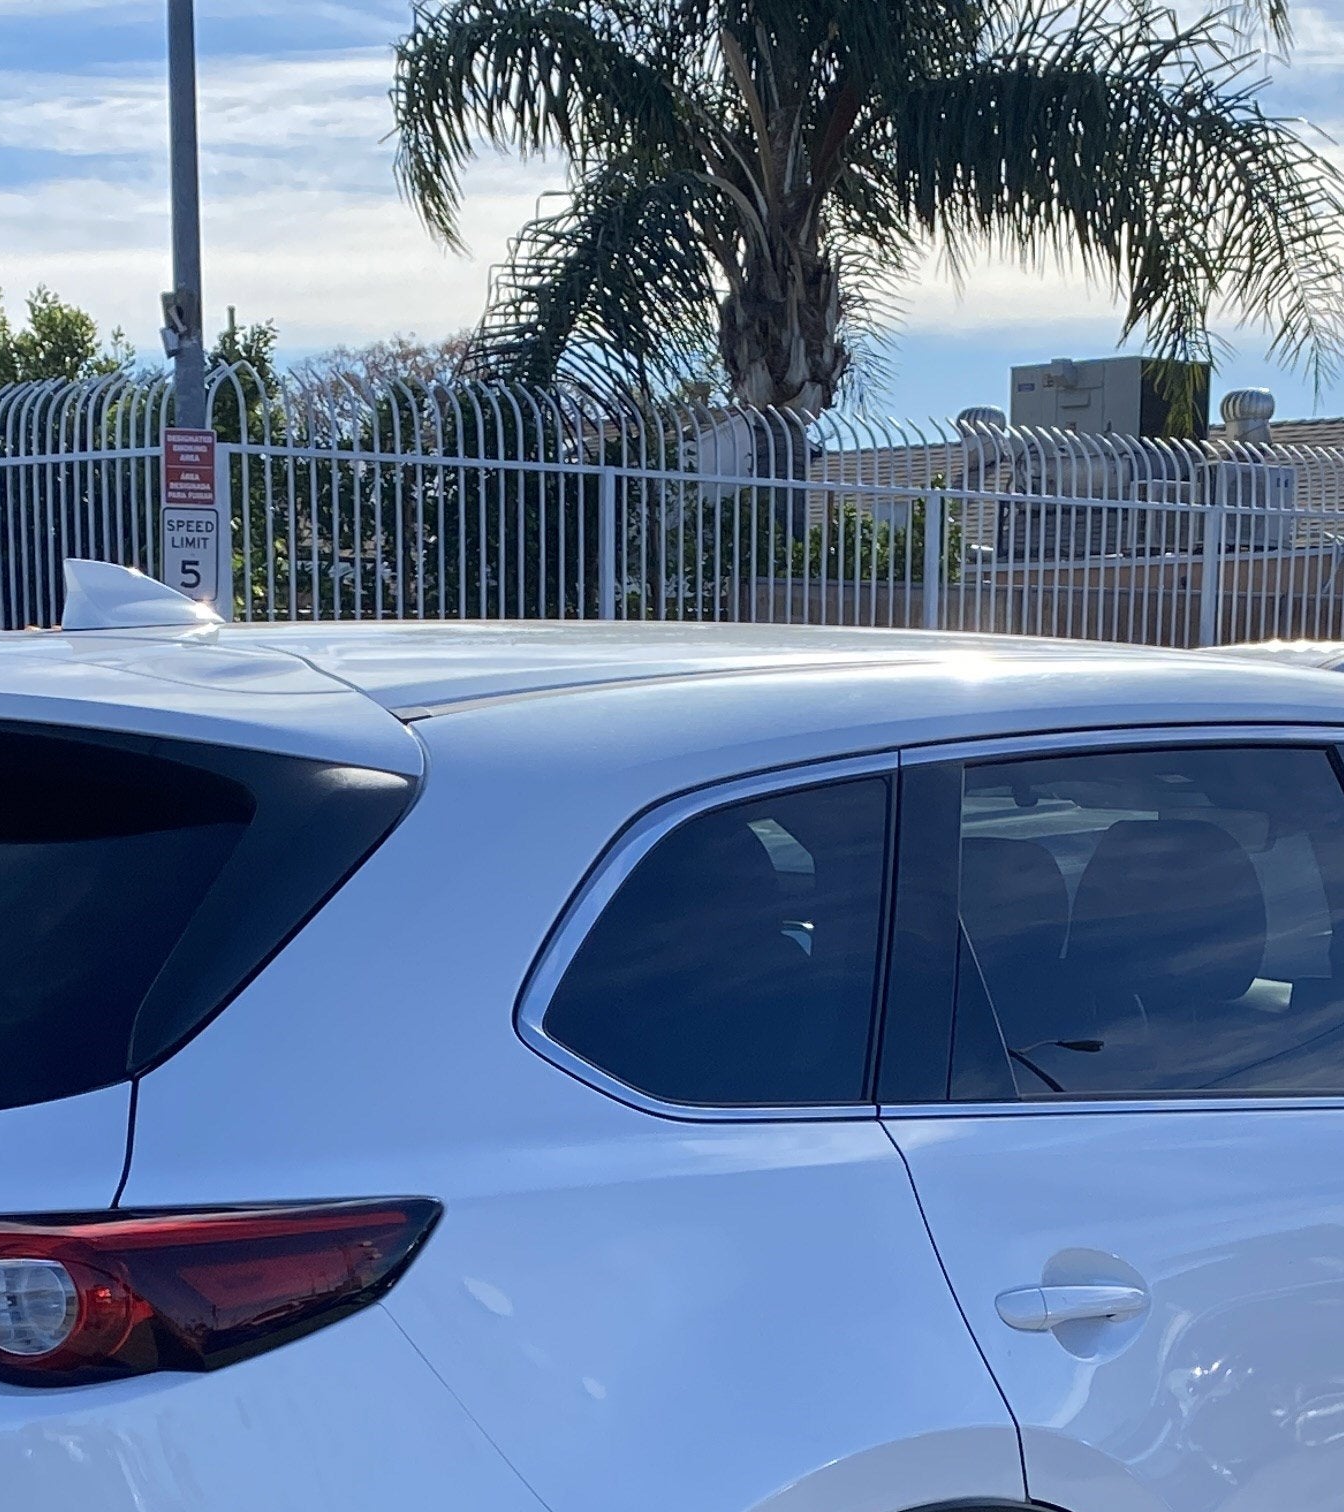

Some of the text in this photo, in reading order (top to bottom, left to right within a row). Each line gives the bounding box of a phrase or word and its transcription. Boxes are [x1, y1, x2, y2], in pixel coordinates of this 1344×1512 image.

[167, 520, 214, 533] SPEED
[171, 537, 210, 549] LIMIT
[180, 560, 201, 589] 5
